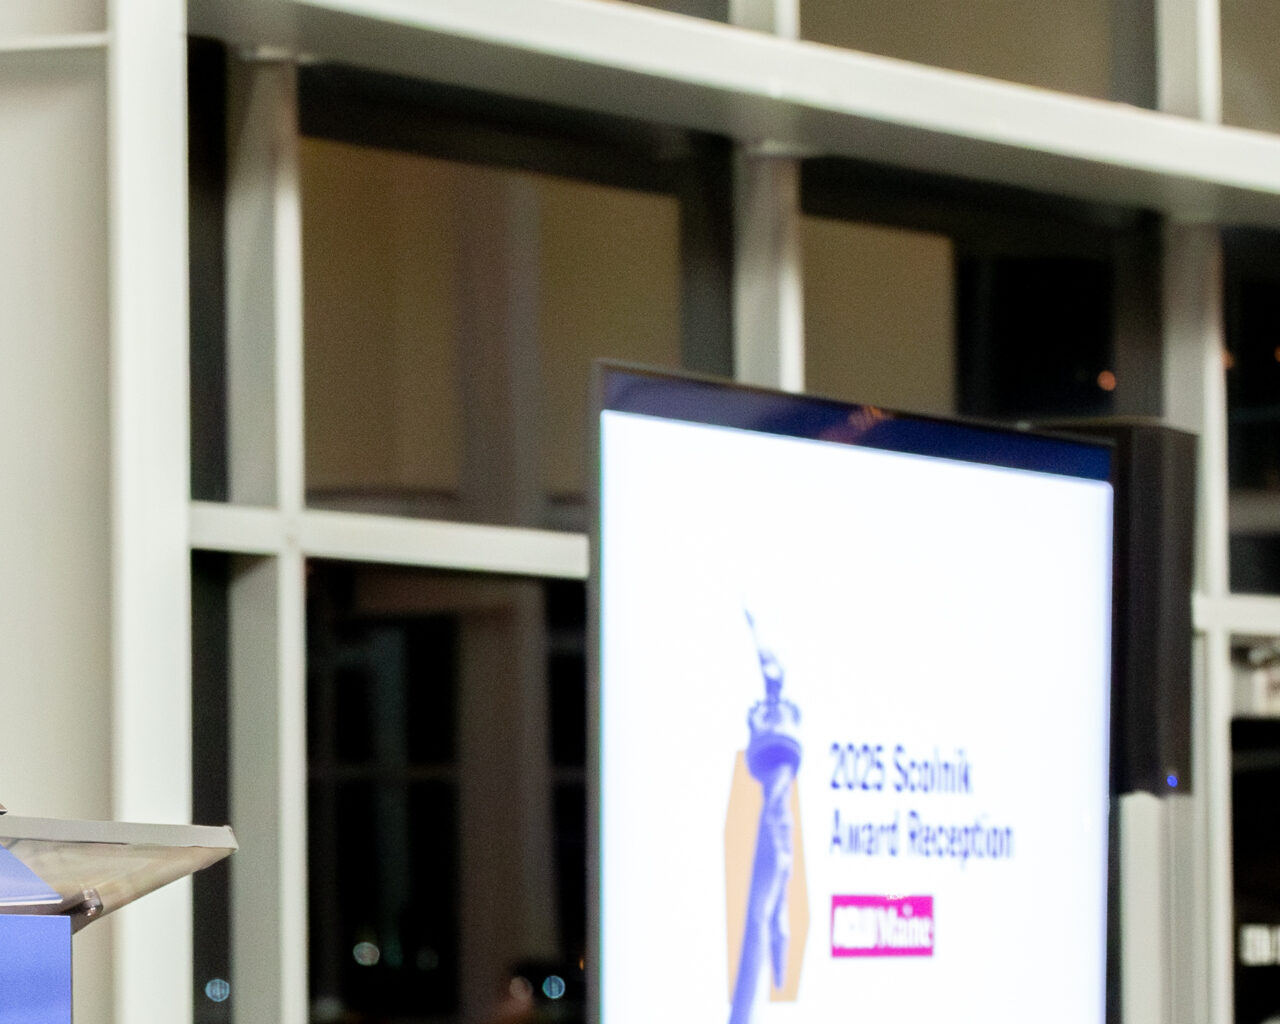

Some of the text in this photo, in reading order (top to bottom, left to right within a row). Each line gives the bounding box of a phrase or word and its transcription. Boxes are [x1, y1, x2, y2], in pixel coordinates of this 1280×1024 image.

[830, 742, 885, 792] 2025
[829, 808, 1015, 872] Award Reception
